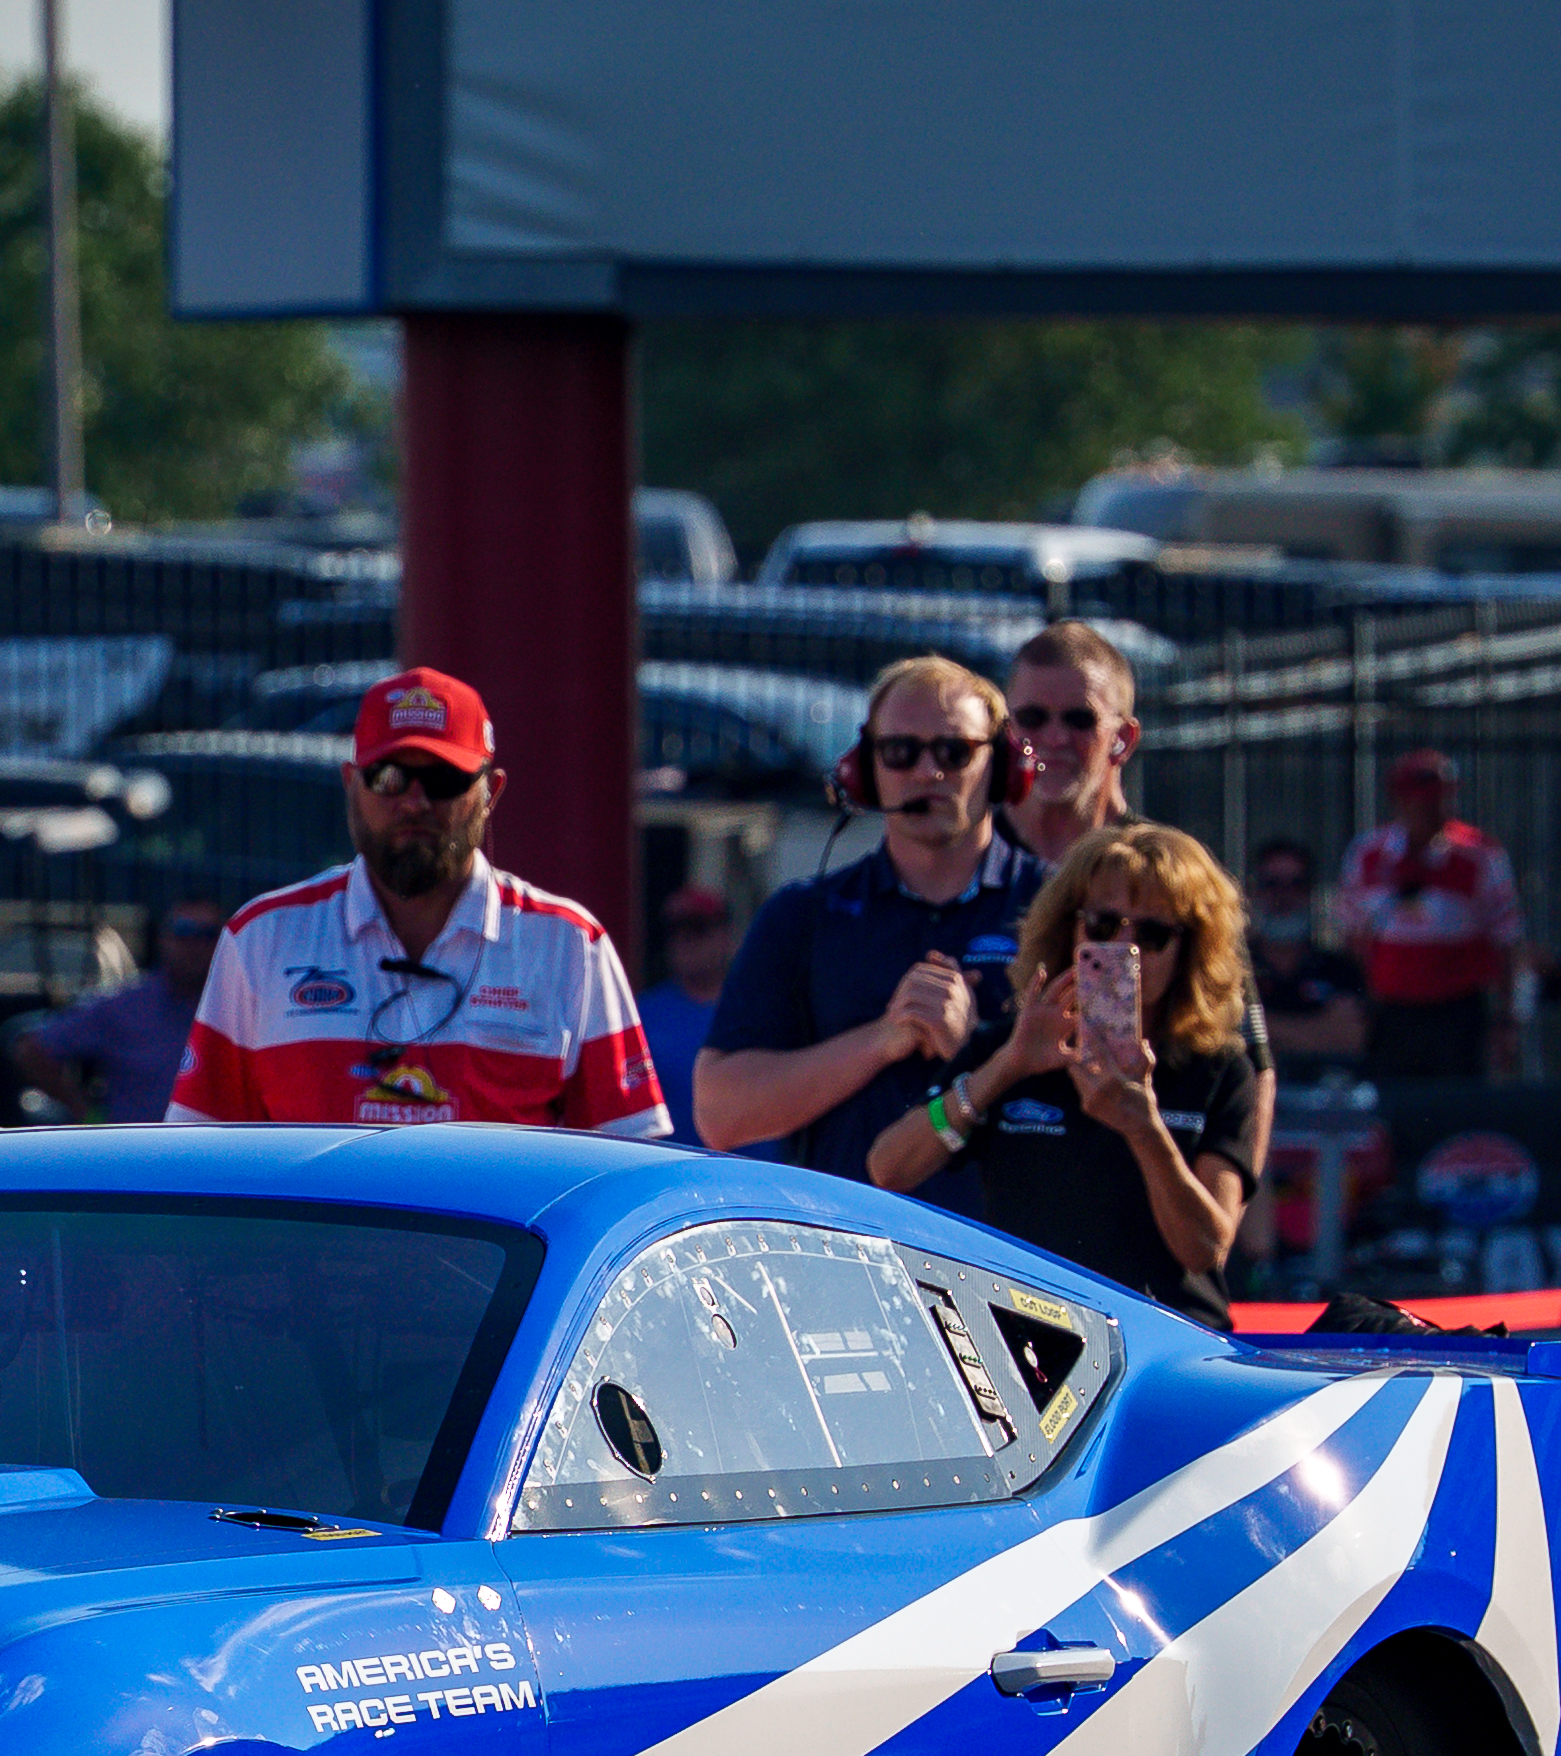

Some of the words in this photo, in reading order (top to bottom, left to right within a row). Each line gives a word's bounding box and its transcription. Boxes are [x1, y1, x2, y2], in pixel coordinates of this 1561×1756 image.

[295, 1641, 518, 1694] AMERICA'S
[306, 1694, 417, 1734] RACE
[417, 1680, 537, 1721] TEAM
